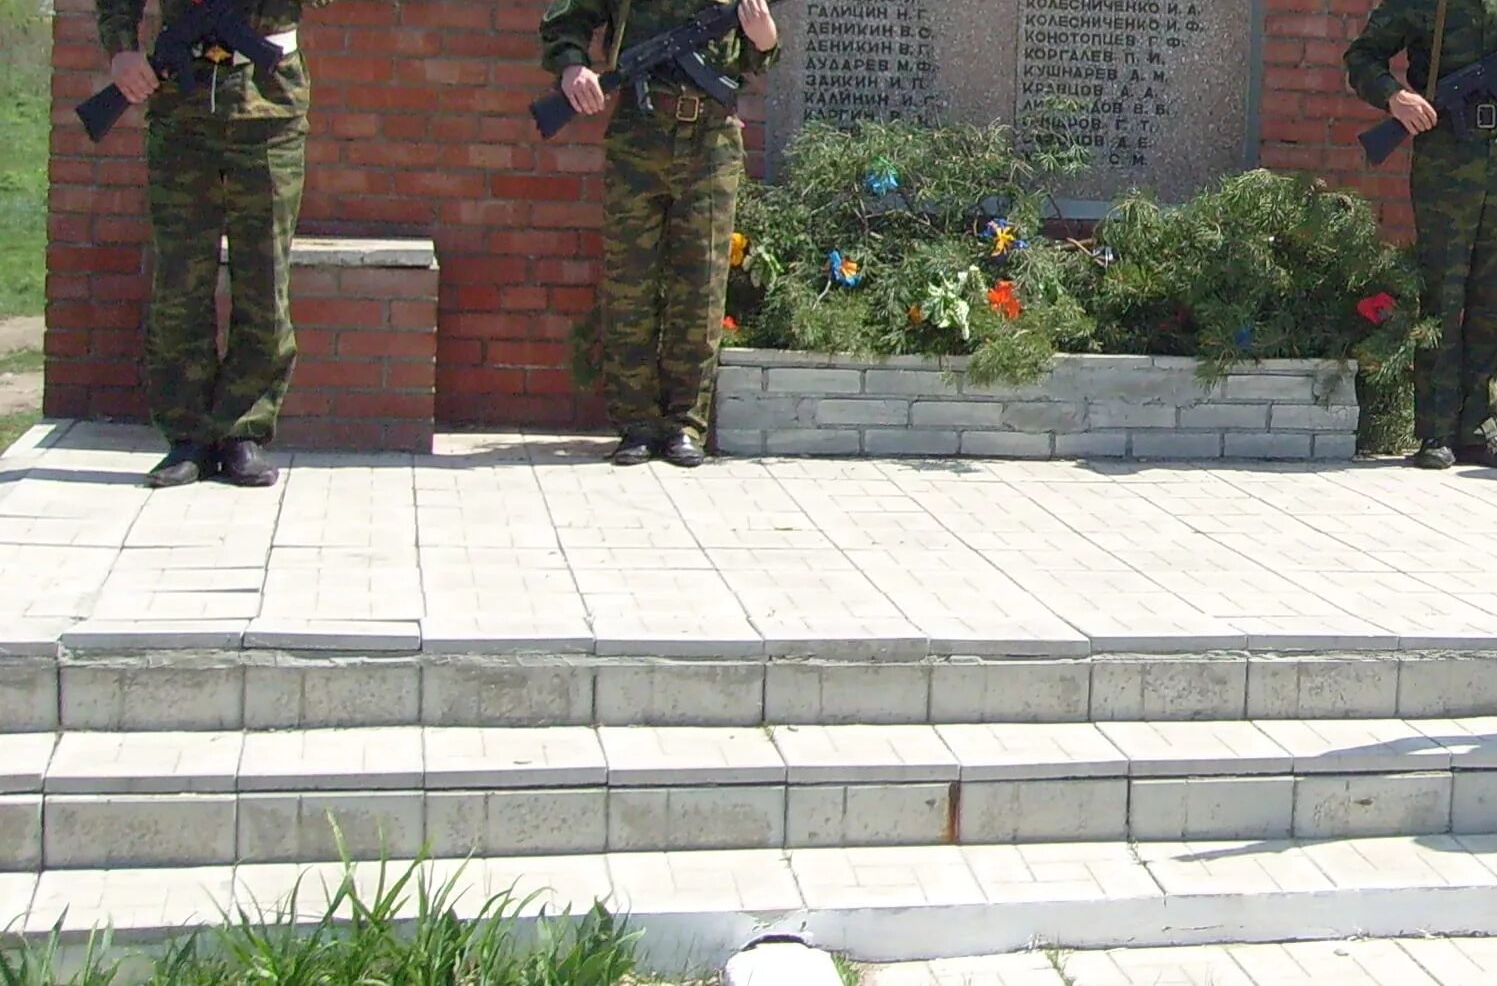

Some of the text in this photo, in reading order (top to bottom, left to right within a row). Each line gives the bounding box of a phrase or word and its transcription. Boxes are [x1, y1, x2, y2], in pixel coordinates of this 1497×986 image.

[807, 5, 888, 20] ГАЛИЦИН
[806, 22, 893, 37] ДЕНИКИН
[1025, 15, 1160, 31] КОЛЕСНИЧЕНКО
[1025, 30, 1136, 47] КОНОТОПЦЕВ
[806, 40, 893, 55] ДЕНИКИН
[1024, 47, 1113, 63] КОРГАЛЕВ
[805, 57, 889, 72] ДУДАРЕВ
[1023, 65, 1118, 81] КУШНАРЕВ
